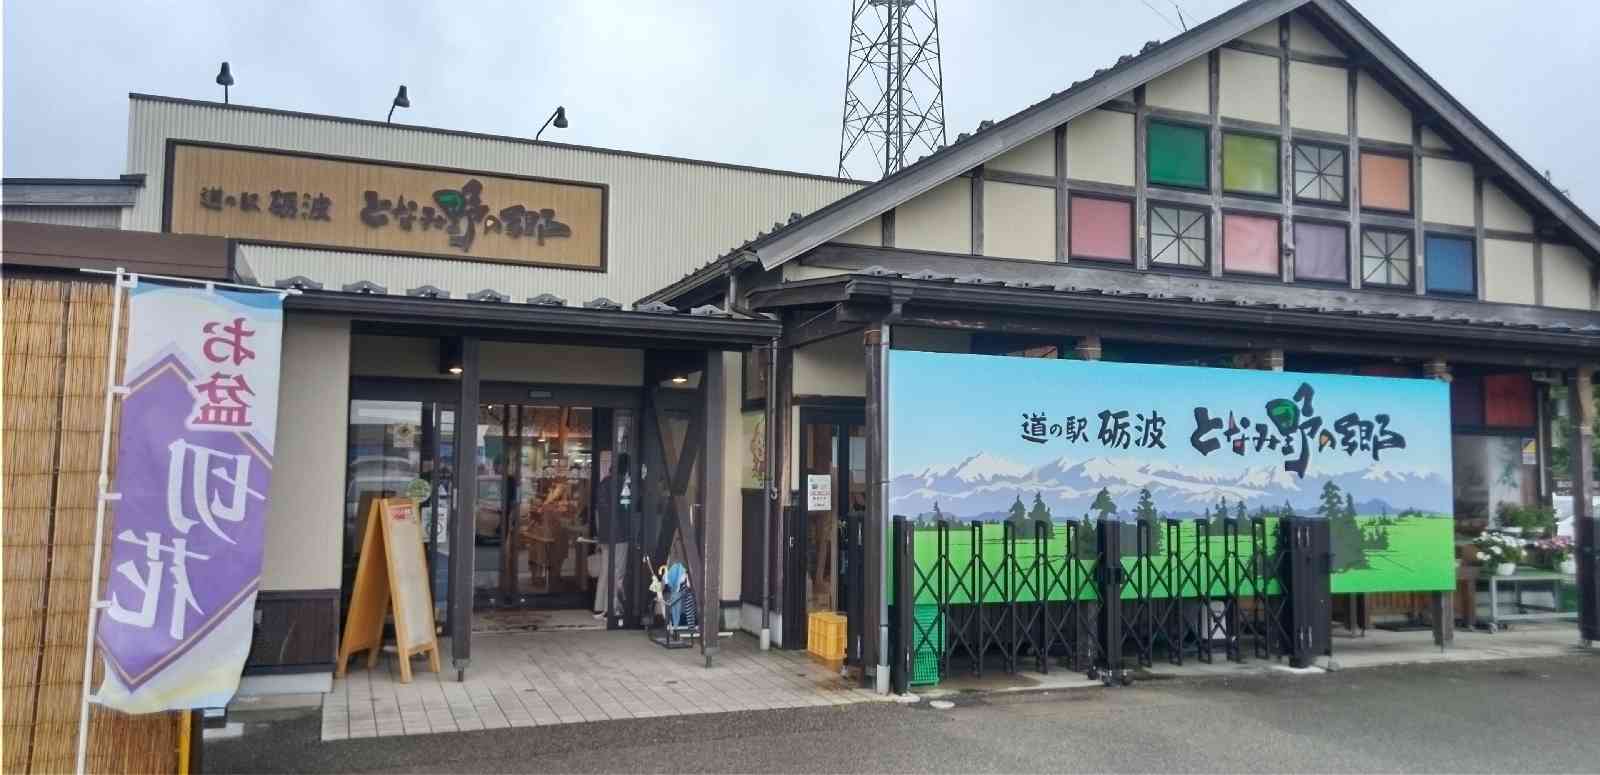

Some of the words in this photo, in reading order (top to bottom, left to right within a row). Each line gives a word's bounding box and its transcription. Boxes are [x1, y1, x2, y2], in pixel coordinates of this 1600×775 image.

[1021, 412, 1090, 444] 道の駅
[1097, 409, 1168, 450] 砺波
[1190, 382, 1406, 478] となみ野の郷
